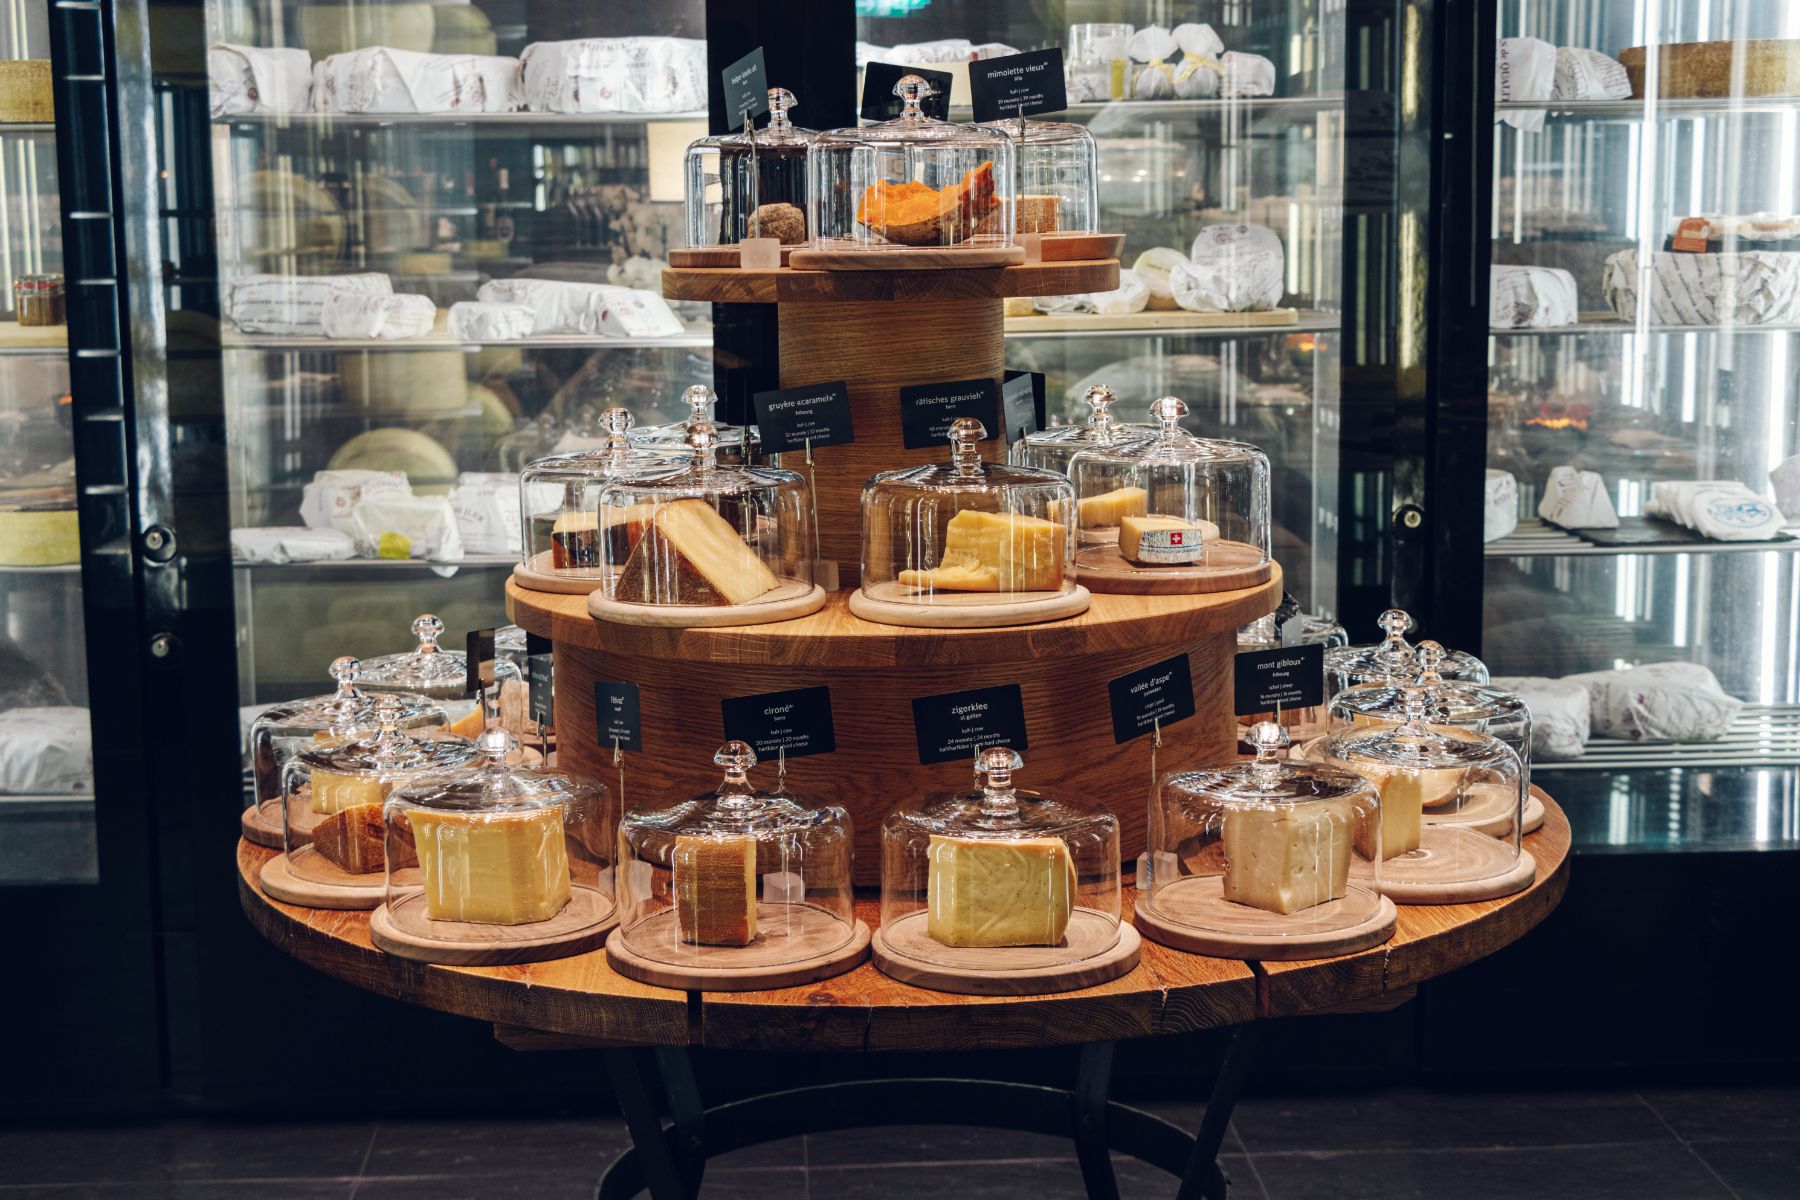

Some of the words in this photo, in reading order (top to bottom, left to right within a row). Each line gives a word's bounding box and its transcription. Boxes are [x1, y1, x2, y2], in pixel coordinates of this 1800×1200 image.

[987, 67, 1024, 78] mimolette
[916, 396, 949, 405] rätisches
[768, 401, 795, 411] gruyère
[1257, 661, 1274, 670] mont
[1130, 683, 1148, 693] vallée
[952, 702, 988, 714] zigerklee
